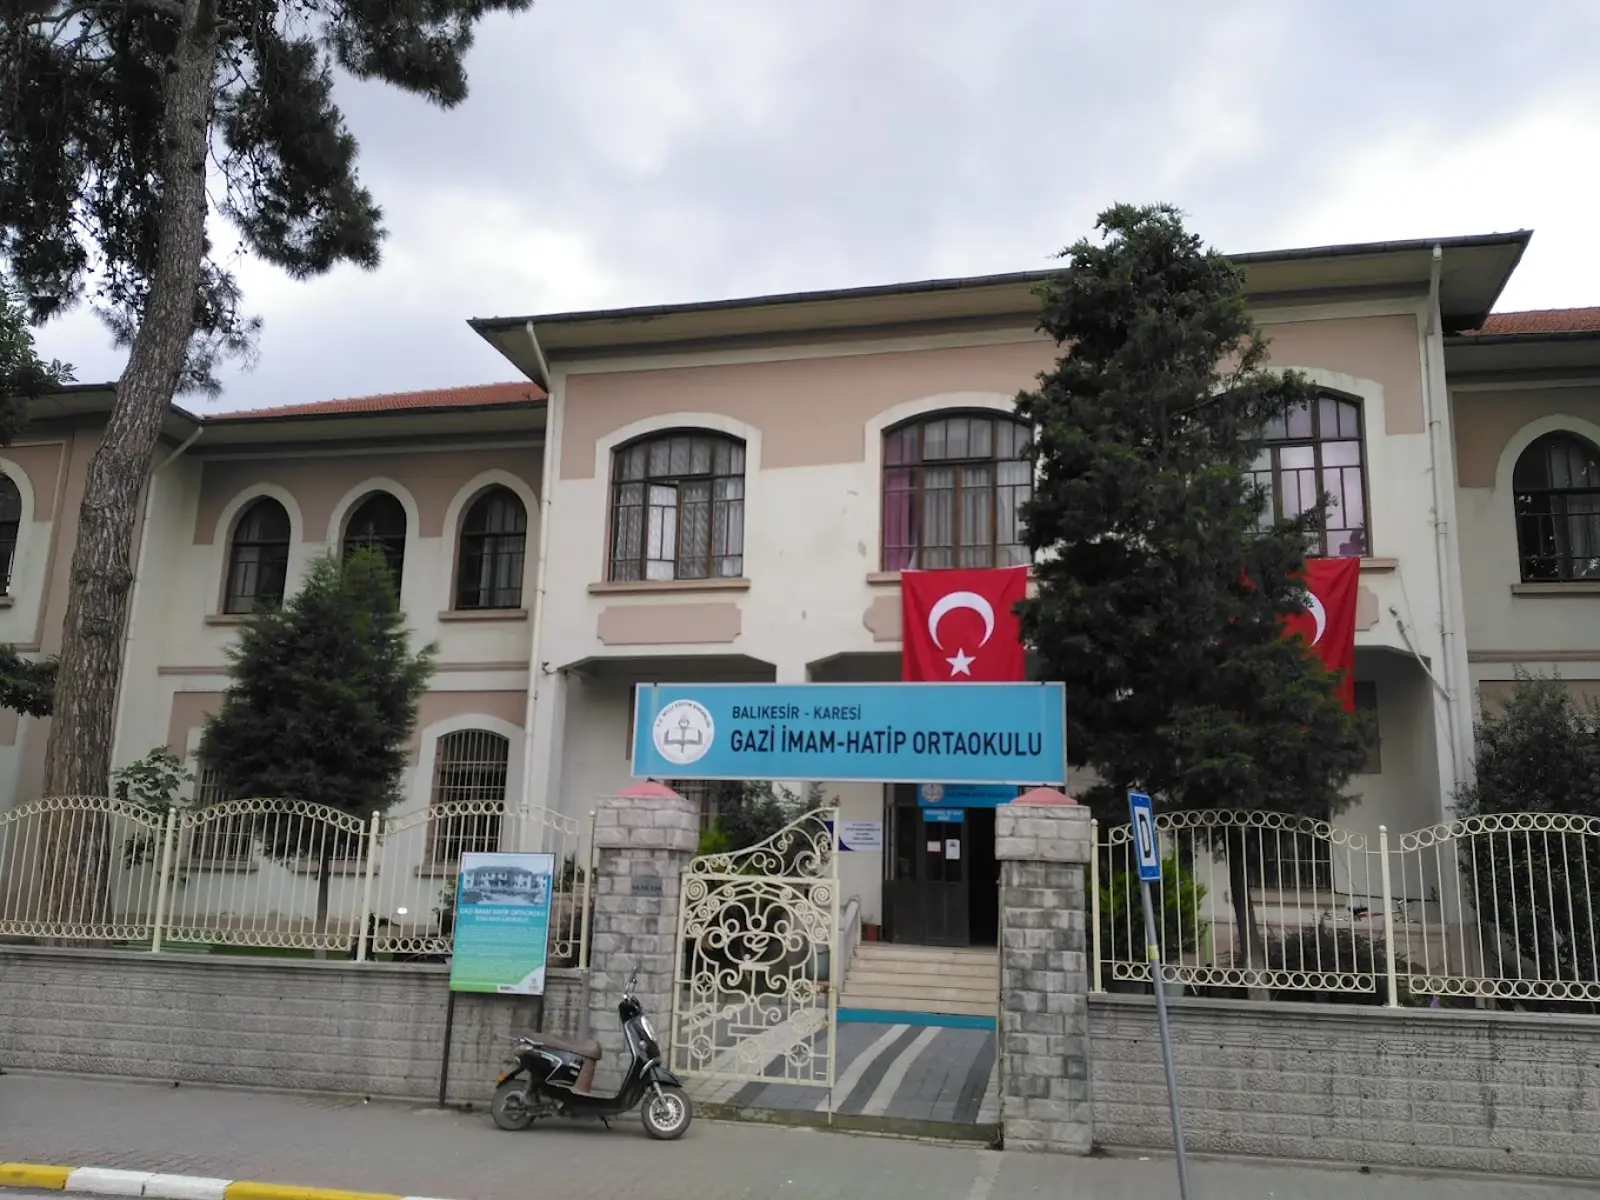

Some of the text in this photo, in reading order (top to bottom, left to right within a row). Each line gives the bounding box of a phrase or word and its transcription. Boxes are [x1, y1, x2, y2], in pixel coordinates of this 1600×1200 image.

[732, 703, 800, 720] BALIKESİR
[813, 704, 861, 721] KARESİ
[730, 724, 1043, 757] GAZİ İMAM-HATİP ORTAOKULU
[1138, 813, 1152, 859] D
